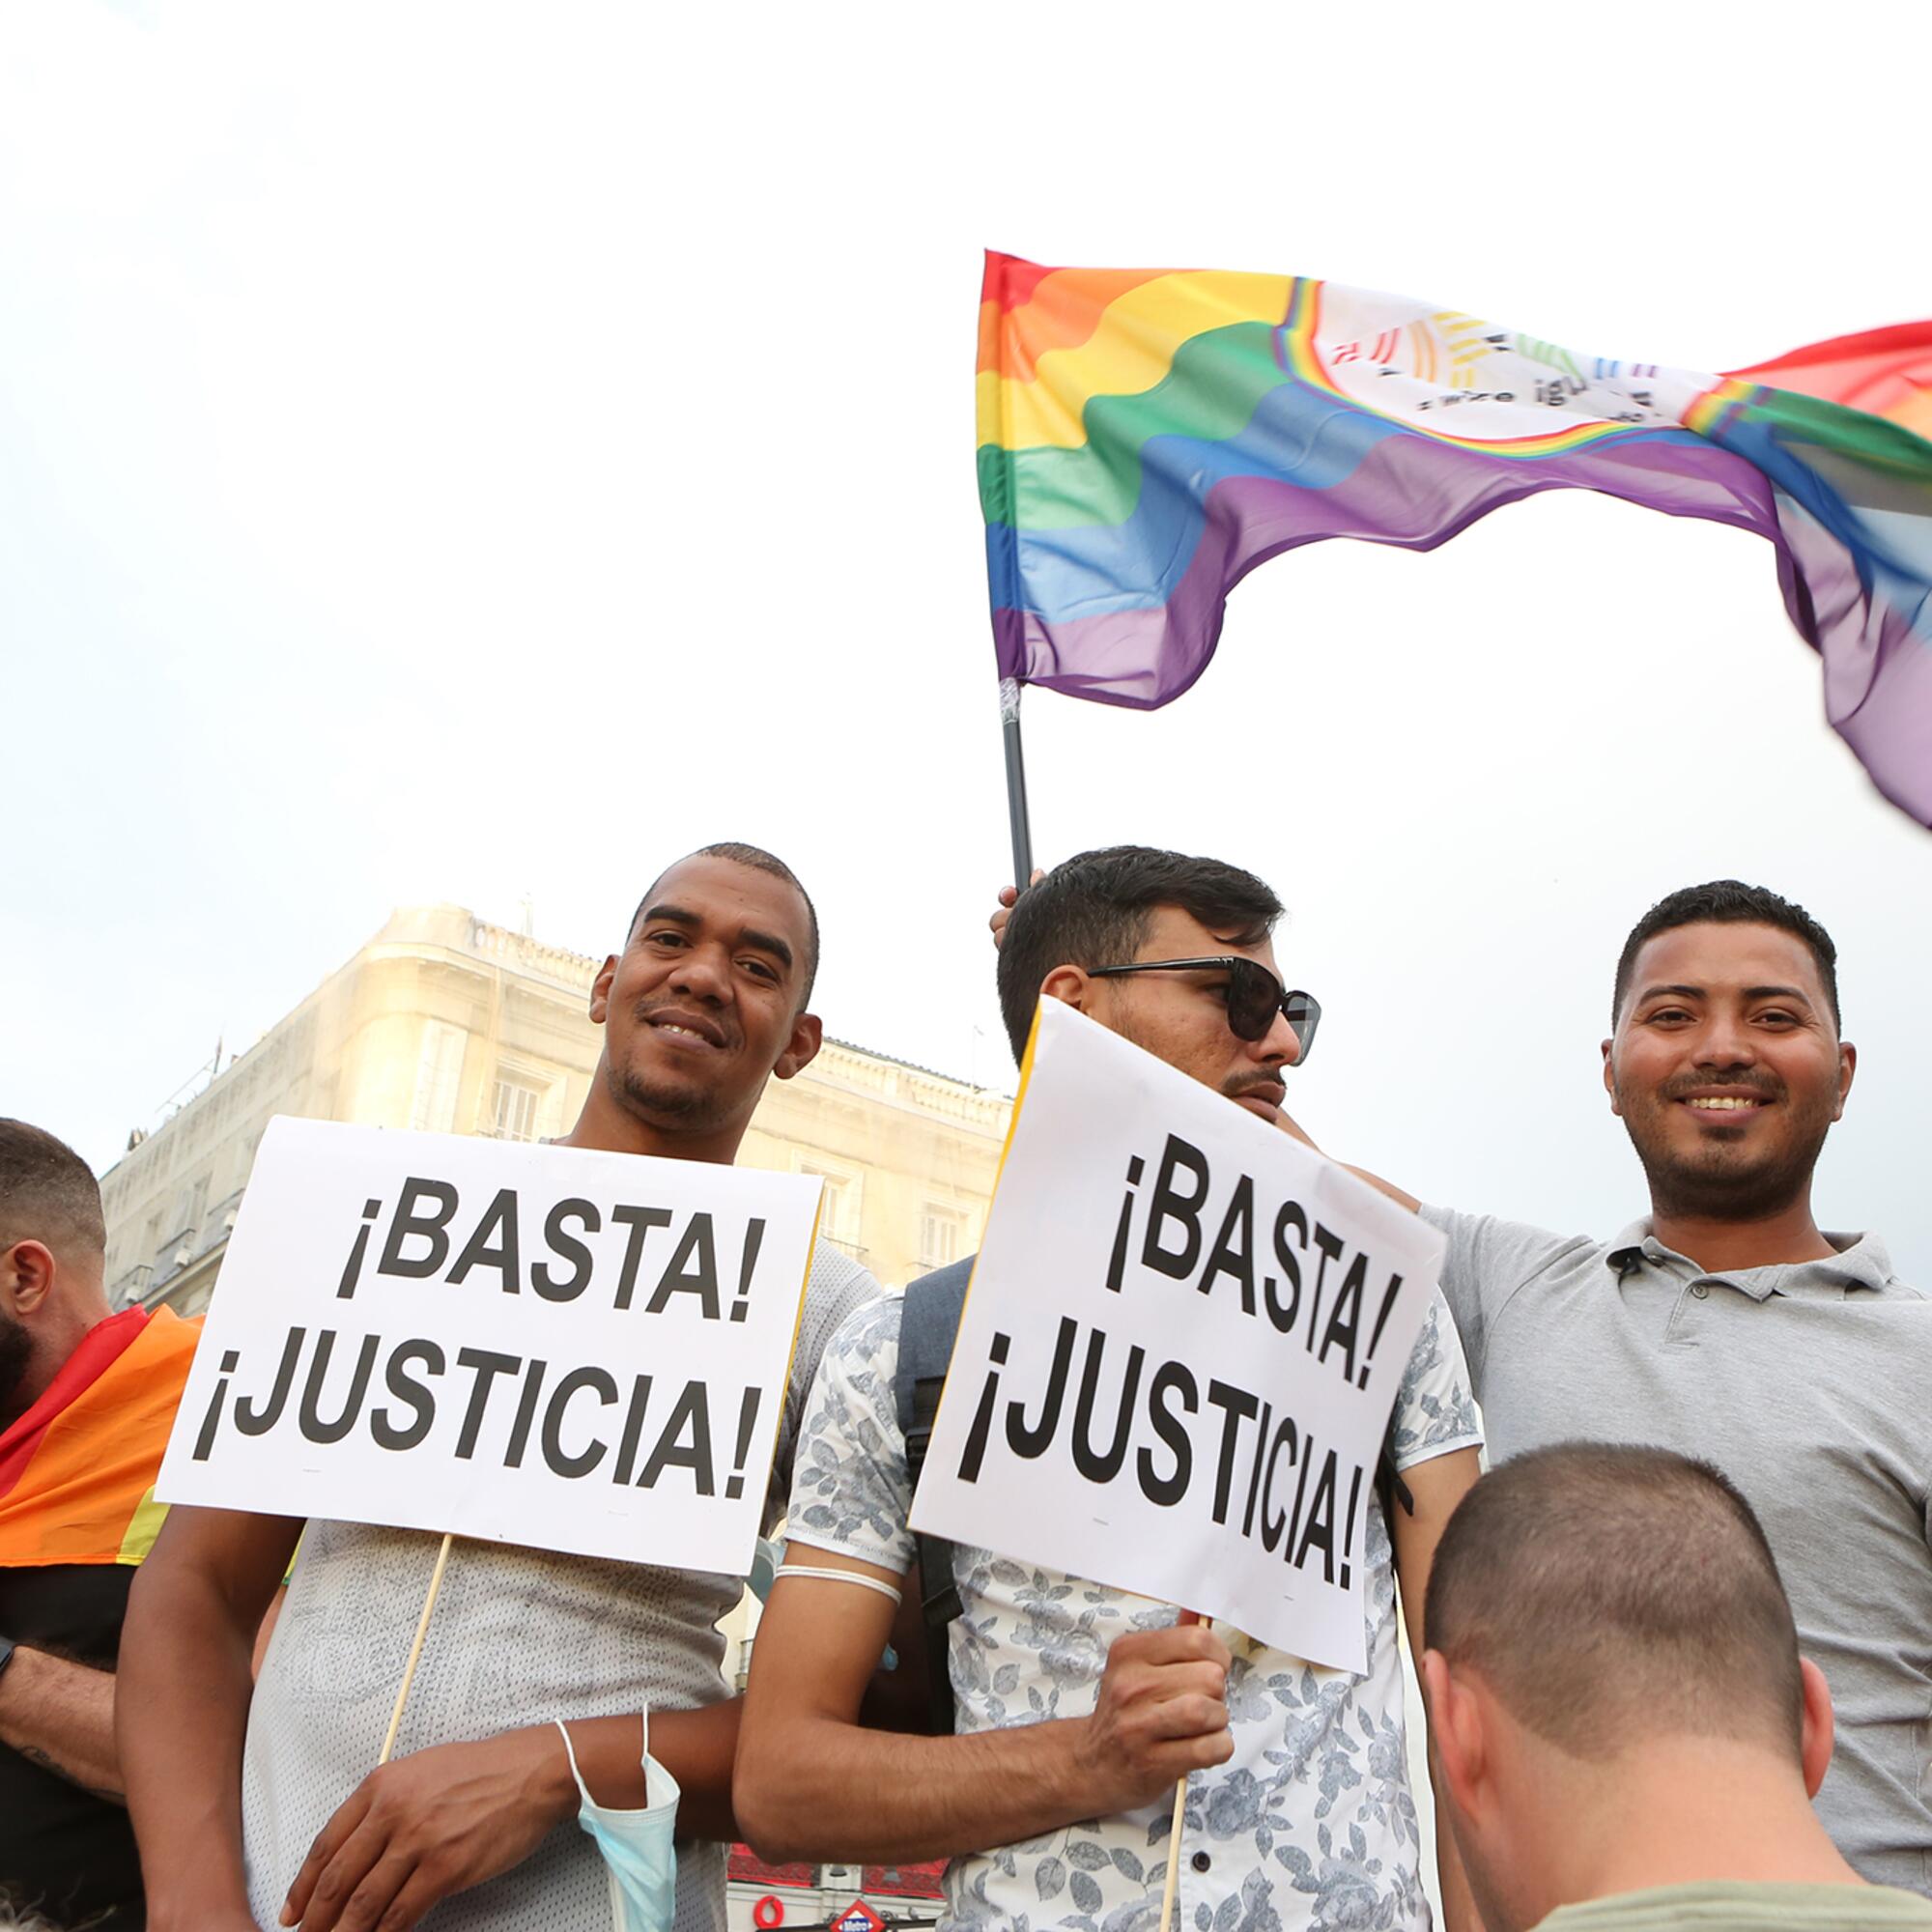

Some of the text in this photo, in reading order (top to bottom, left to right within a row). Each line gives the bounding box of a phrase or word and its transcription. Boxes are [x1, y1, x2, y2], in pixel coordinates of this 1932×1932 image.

[336, 1177, 766, 1322] ¡BASTA!
[1105, 1133, 1404, 1391] ¡BASTA!
[192, 1326, 762, 1499] ¡JUSTICIA!
[957, 1316, 1363, 1591] ¡JUSTICIA!
[843, 1920, 868, 1932] Metro
